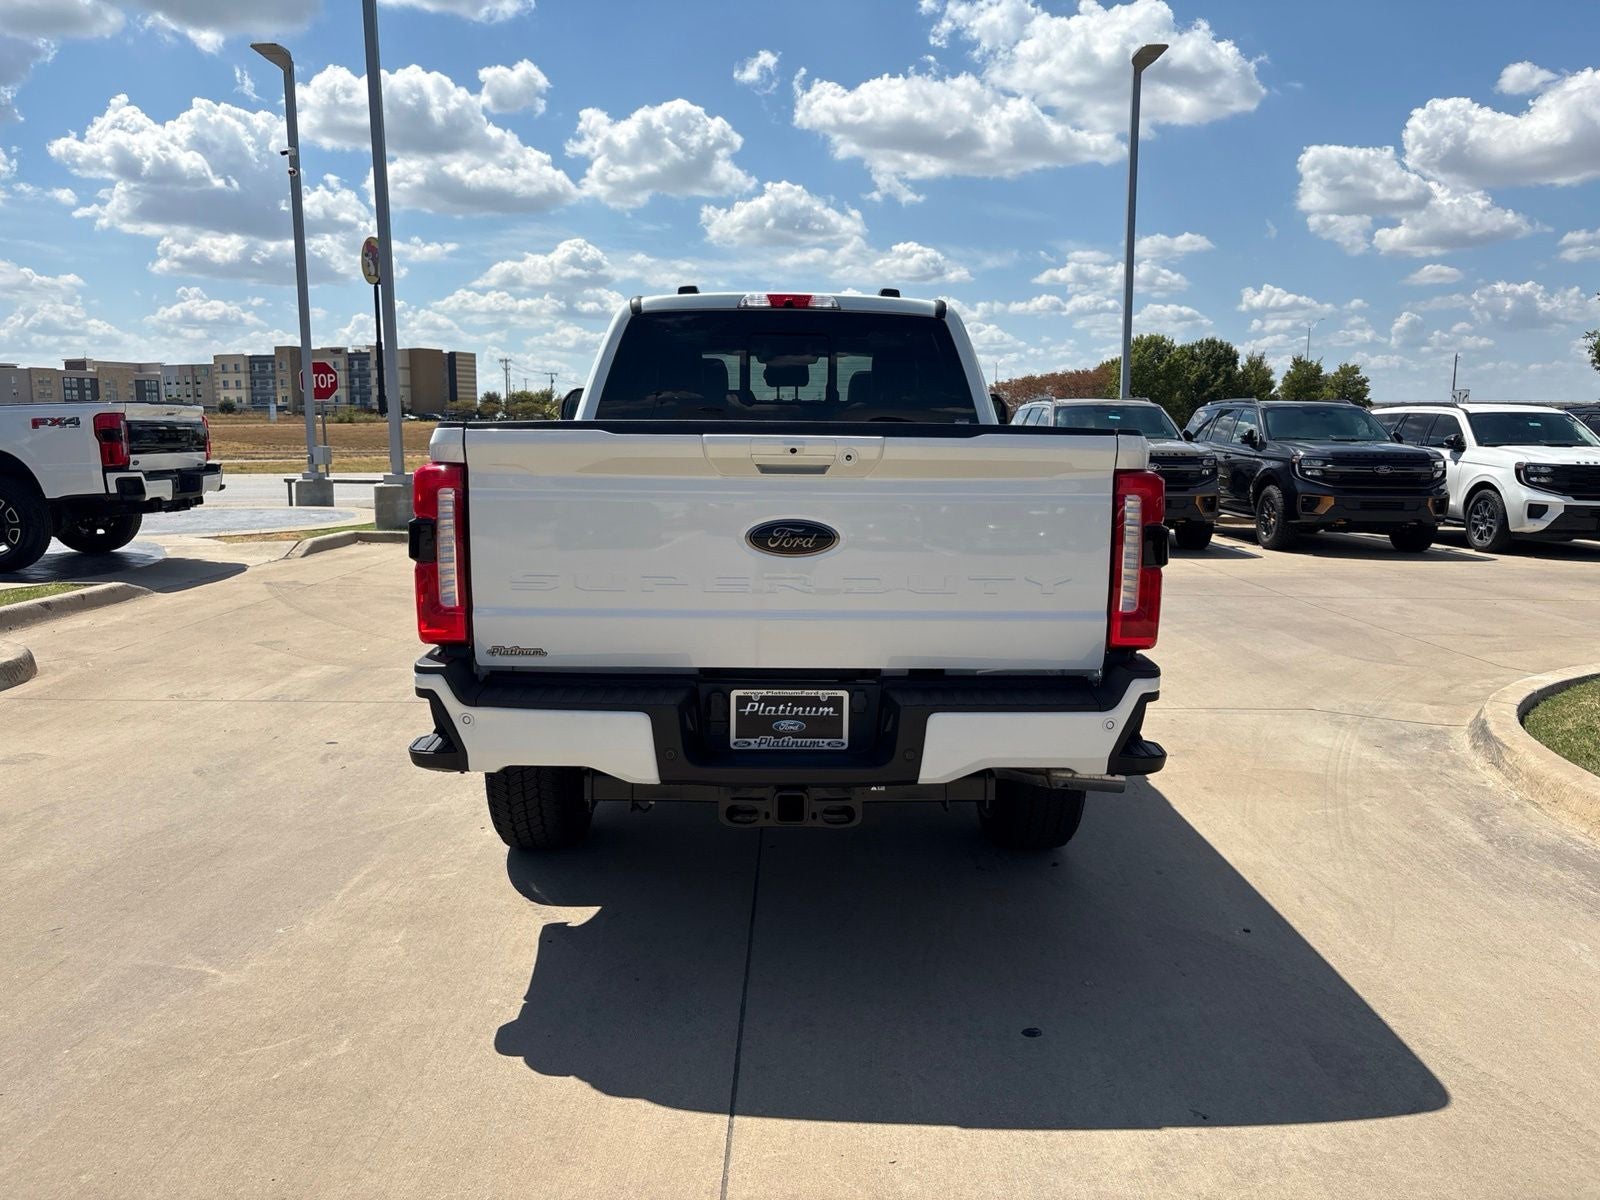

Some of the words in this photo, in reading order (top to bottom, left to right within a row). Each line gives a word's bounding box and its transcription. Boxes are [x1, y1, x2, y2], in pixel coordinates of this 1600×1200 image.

[313, 373, 336, 388] TOP
[31, 416, 81, 429] FX4
[767, 526, 817, 548] Ford
[486, 645, 548, 657] Platinum
[738, 702, 839, 716] Platinum
[778, 721, 800, 731] Ford
[757, 736, 825, 748] Platinum
